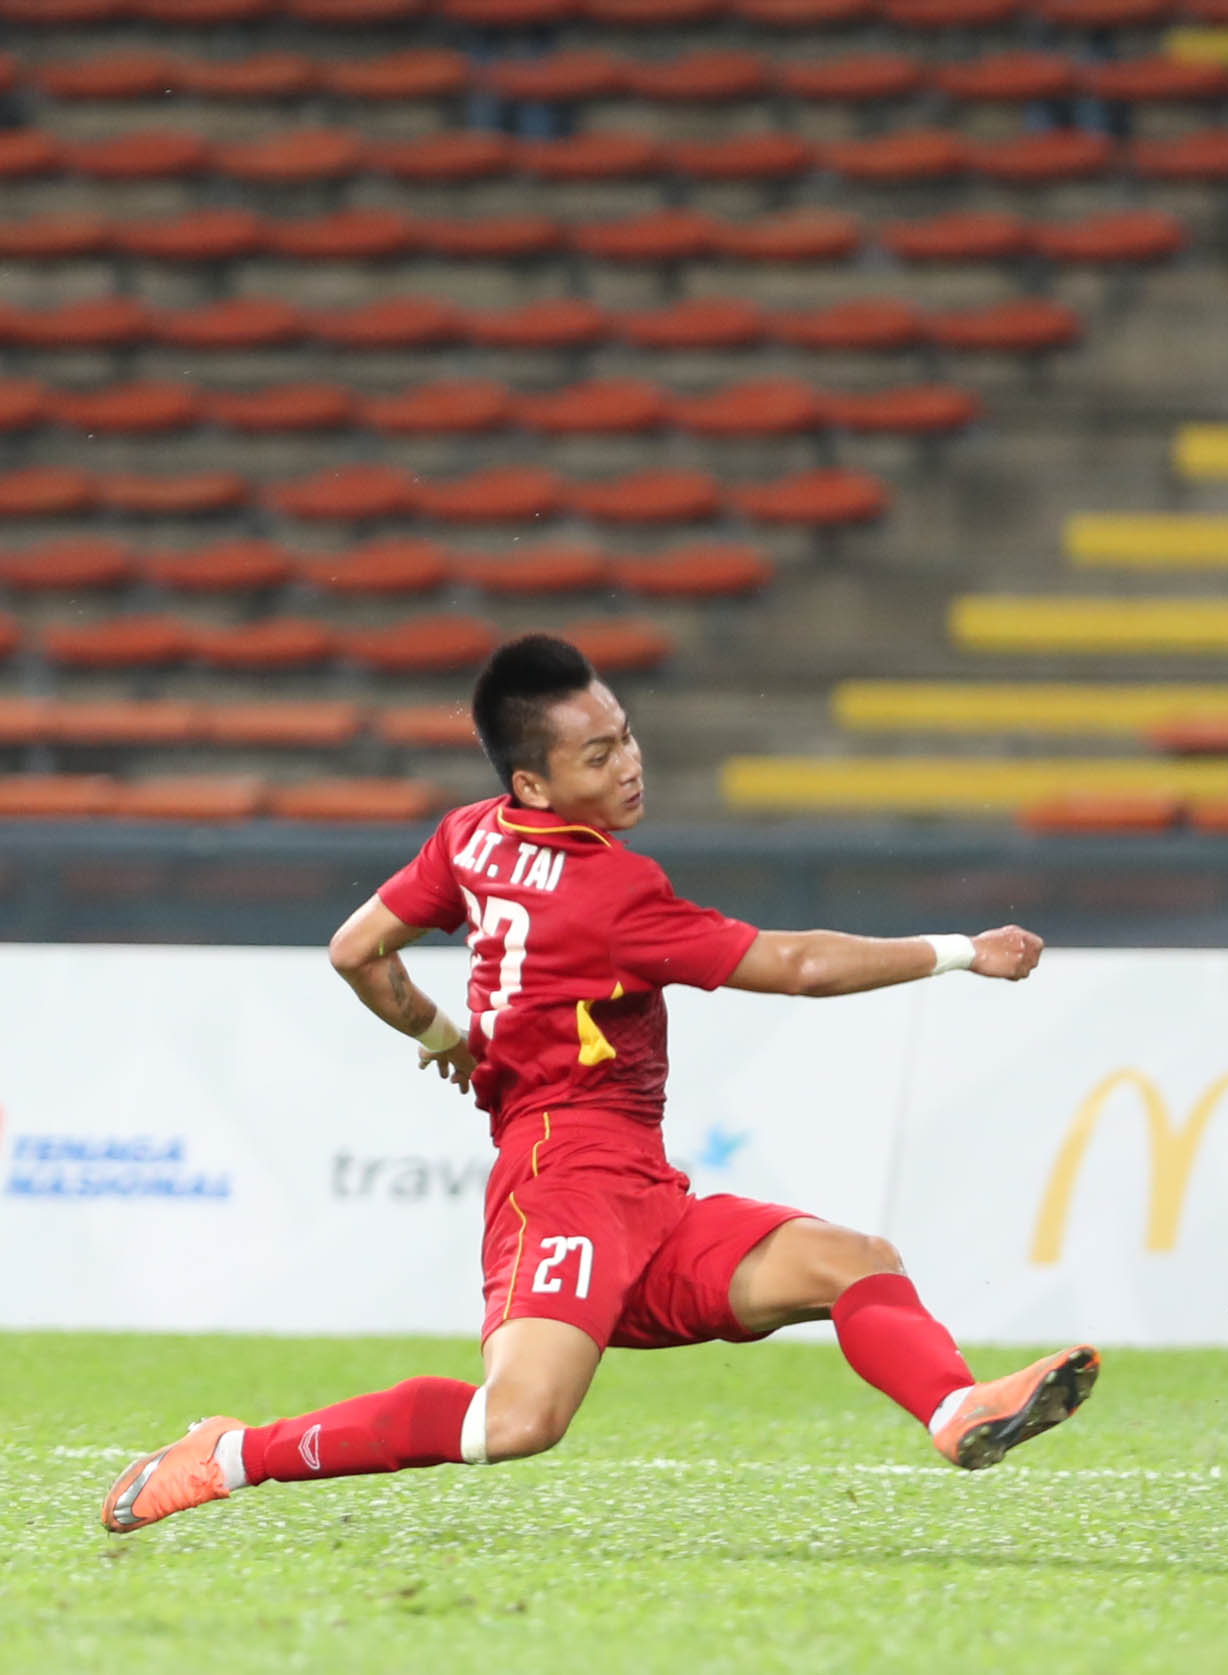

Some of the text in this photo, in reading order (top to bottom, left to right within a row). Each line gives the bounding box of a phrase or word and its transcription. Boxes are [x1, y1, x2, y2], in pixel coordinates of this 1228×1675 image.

[510, 842, 565, 891] TAI
[332, 1148, 490, 1199] trav
[531, 1235, 594, 1299] 27
